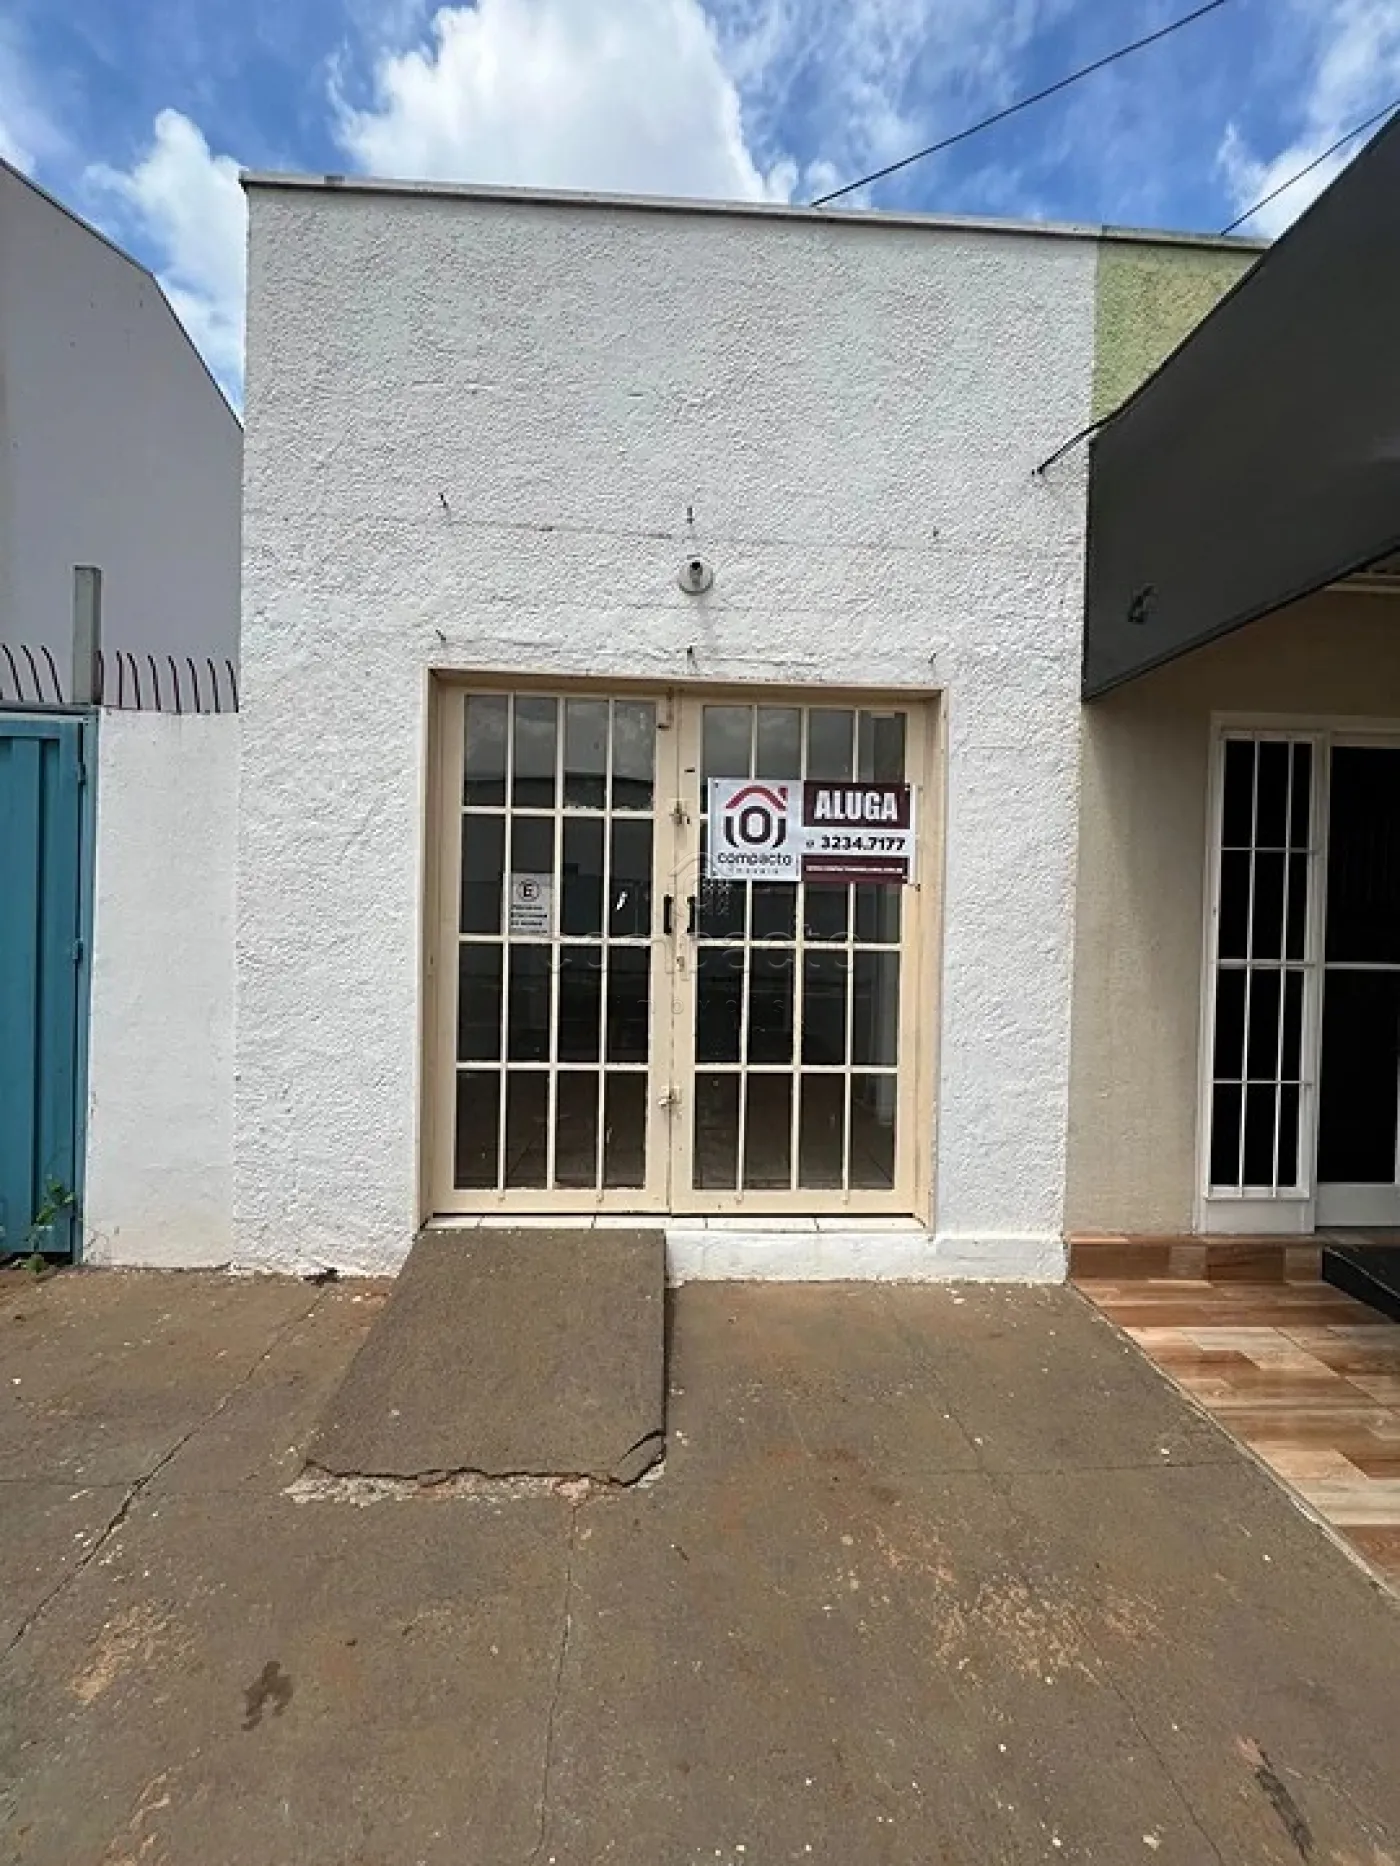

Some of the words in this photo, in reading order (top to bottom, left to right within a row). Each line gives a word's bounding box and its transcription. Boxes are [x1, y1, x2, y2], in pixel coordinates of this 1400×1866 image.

[814, 790, 898, 821] ALUGA
[820, 835, 906, 851] 3234.7177
[717, 851, 792, 867] compacto
